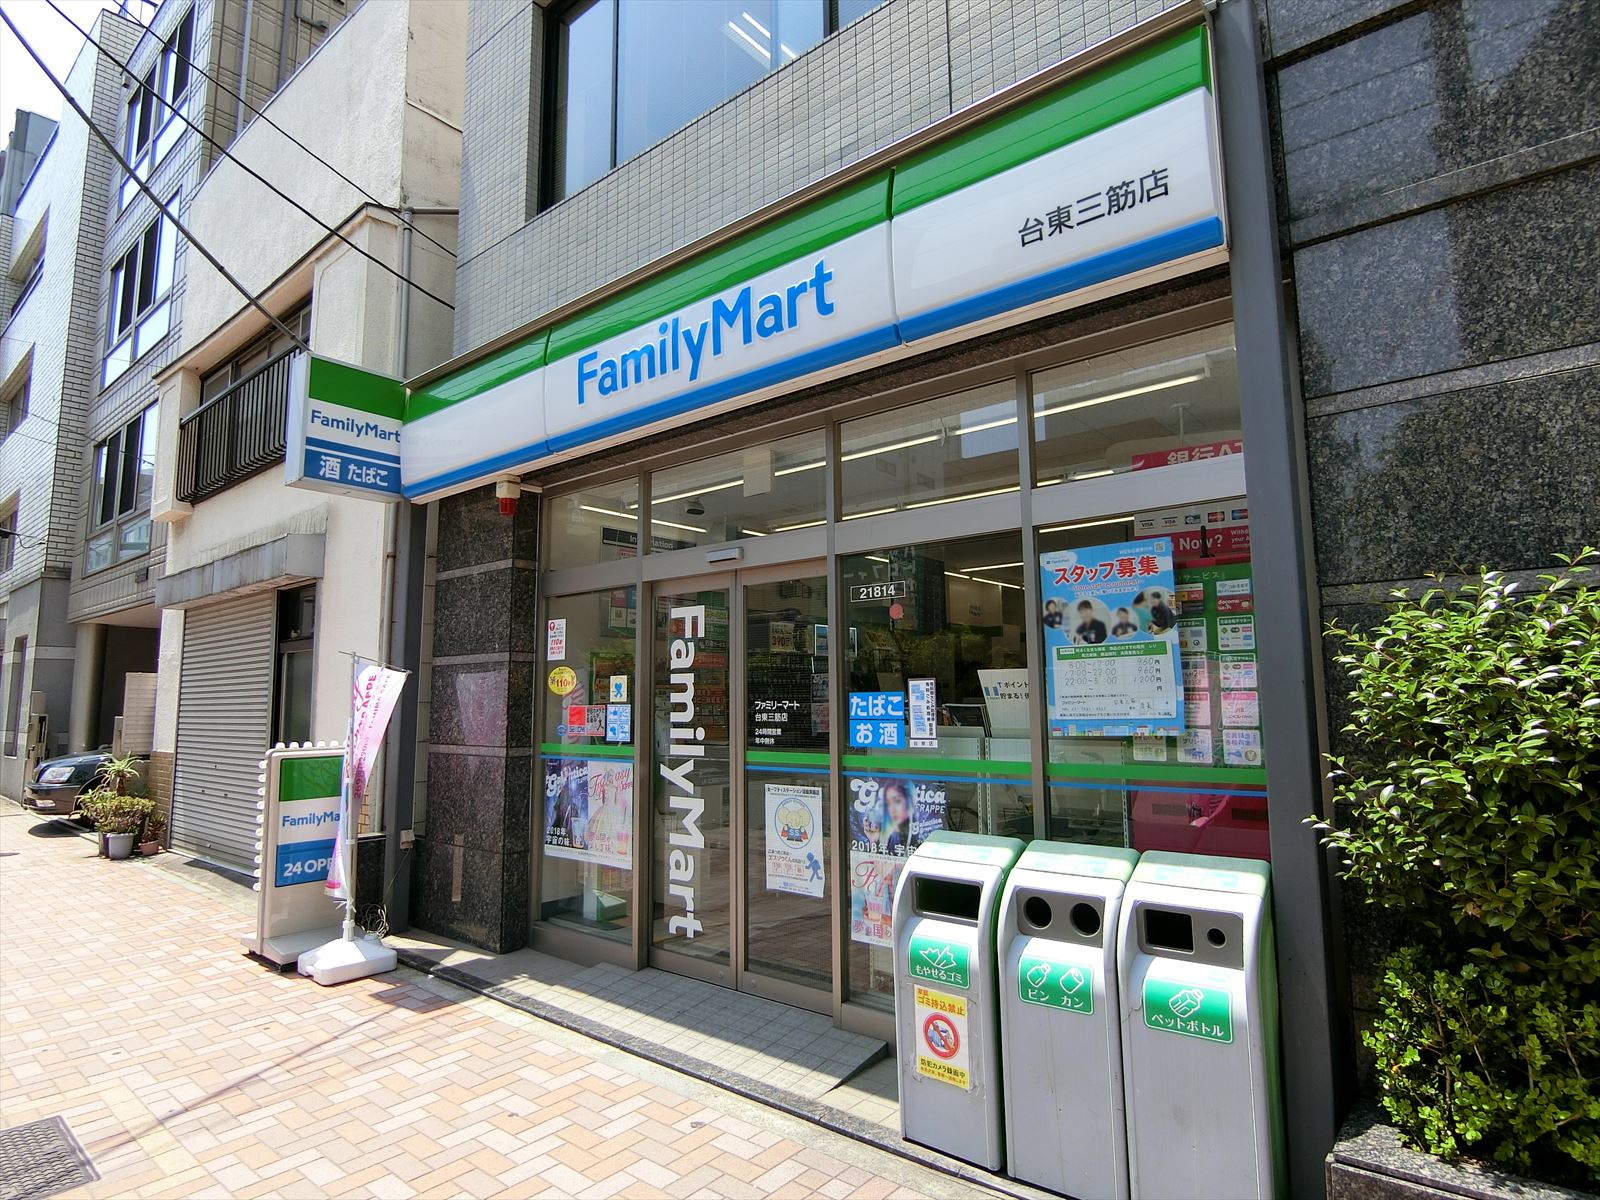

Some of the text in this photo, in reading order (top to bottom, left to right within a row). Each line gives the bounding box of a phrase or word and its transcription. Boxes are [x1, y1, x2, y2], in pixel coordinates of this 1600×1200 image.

[1018, 168, 1169, 247] 台東三筋店
[577, 258, 835, 405] FamilyMart
[311, 409, 401, 444] FamilyMart
[319, 454, 389, 487] 酒 たばこ
[1054, 555, 1159, 585] スタッフ募集
[859, 584, 896, 599] 21814
[754, 701, 801, 711] ファミリーマート
[850, 695, 904, 717] たばこ
[755, 711, 789, 724] 台東三筋店
[855, 723, 898, 746] お酒
[660, 604, 706, 939] FamilyMart
[283, 862, 302, 877] 24
[915, 964, 963, 983] もやせるゴミ
[918, 995, 966, 1017] ゴミ持込禁止
[1027, 988, 1084, 1009] ビン カン
[1151, 1014, 1225, 1038] ペットボトル
